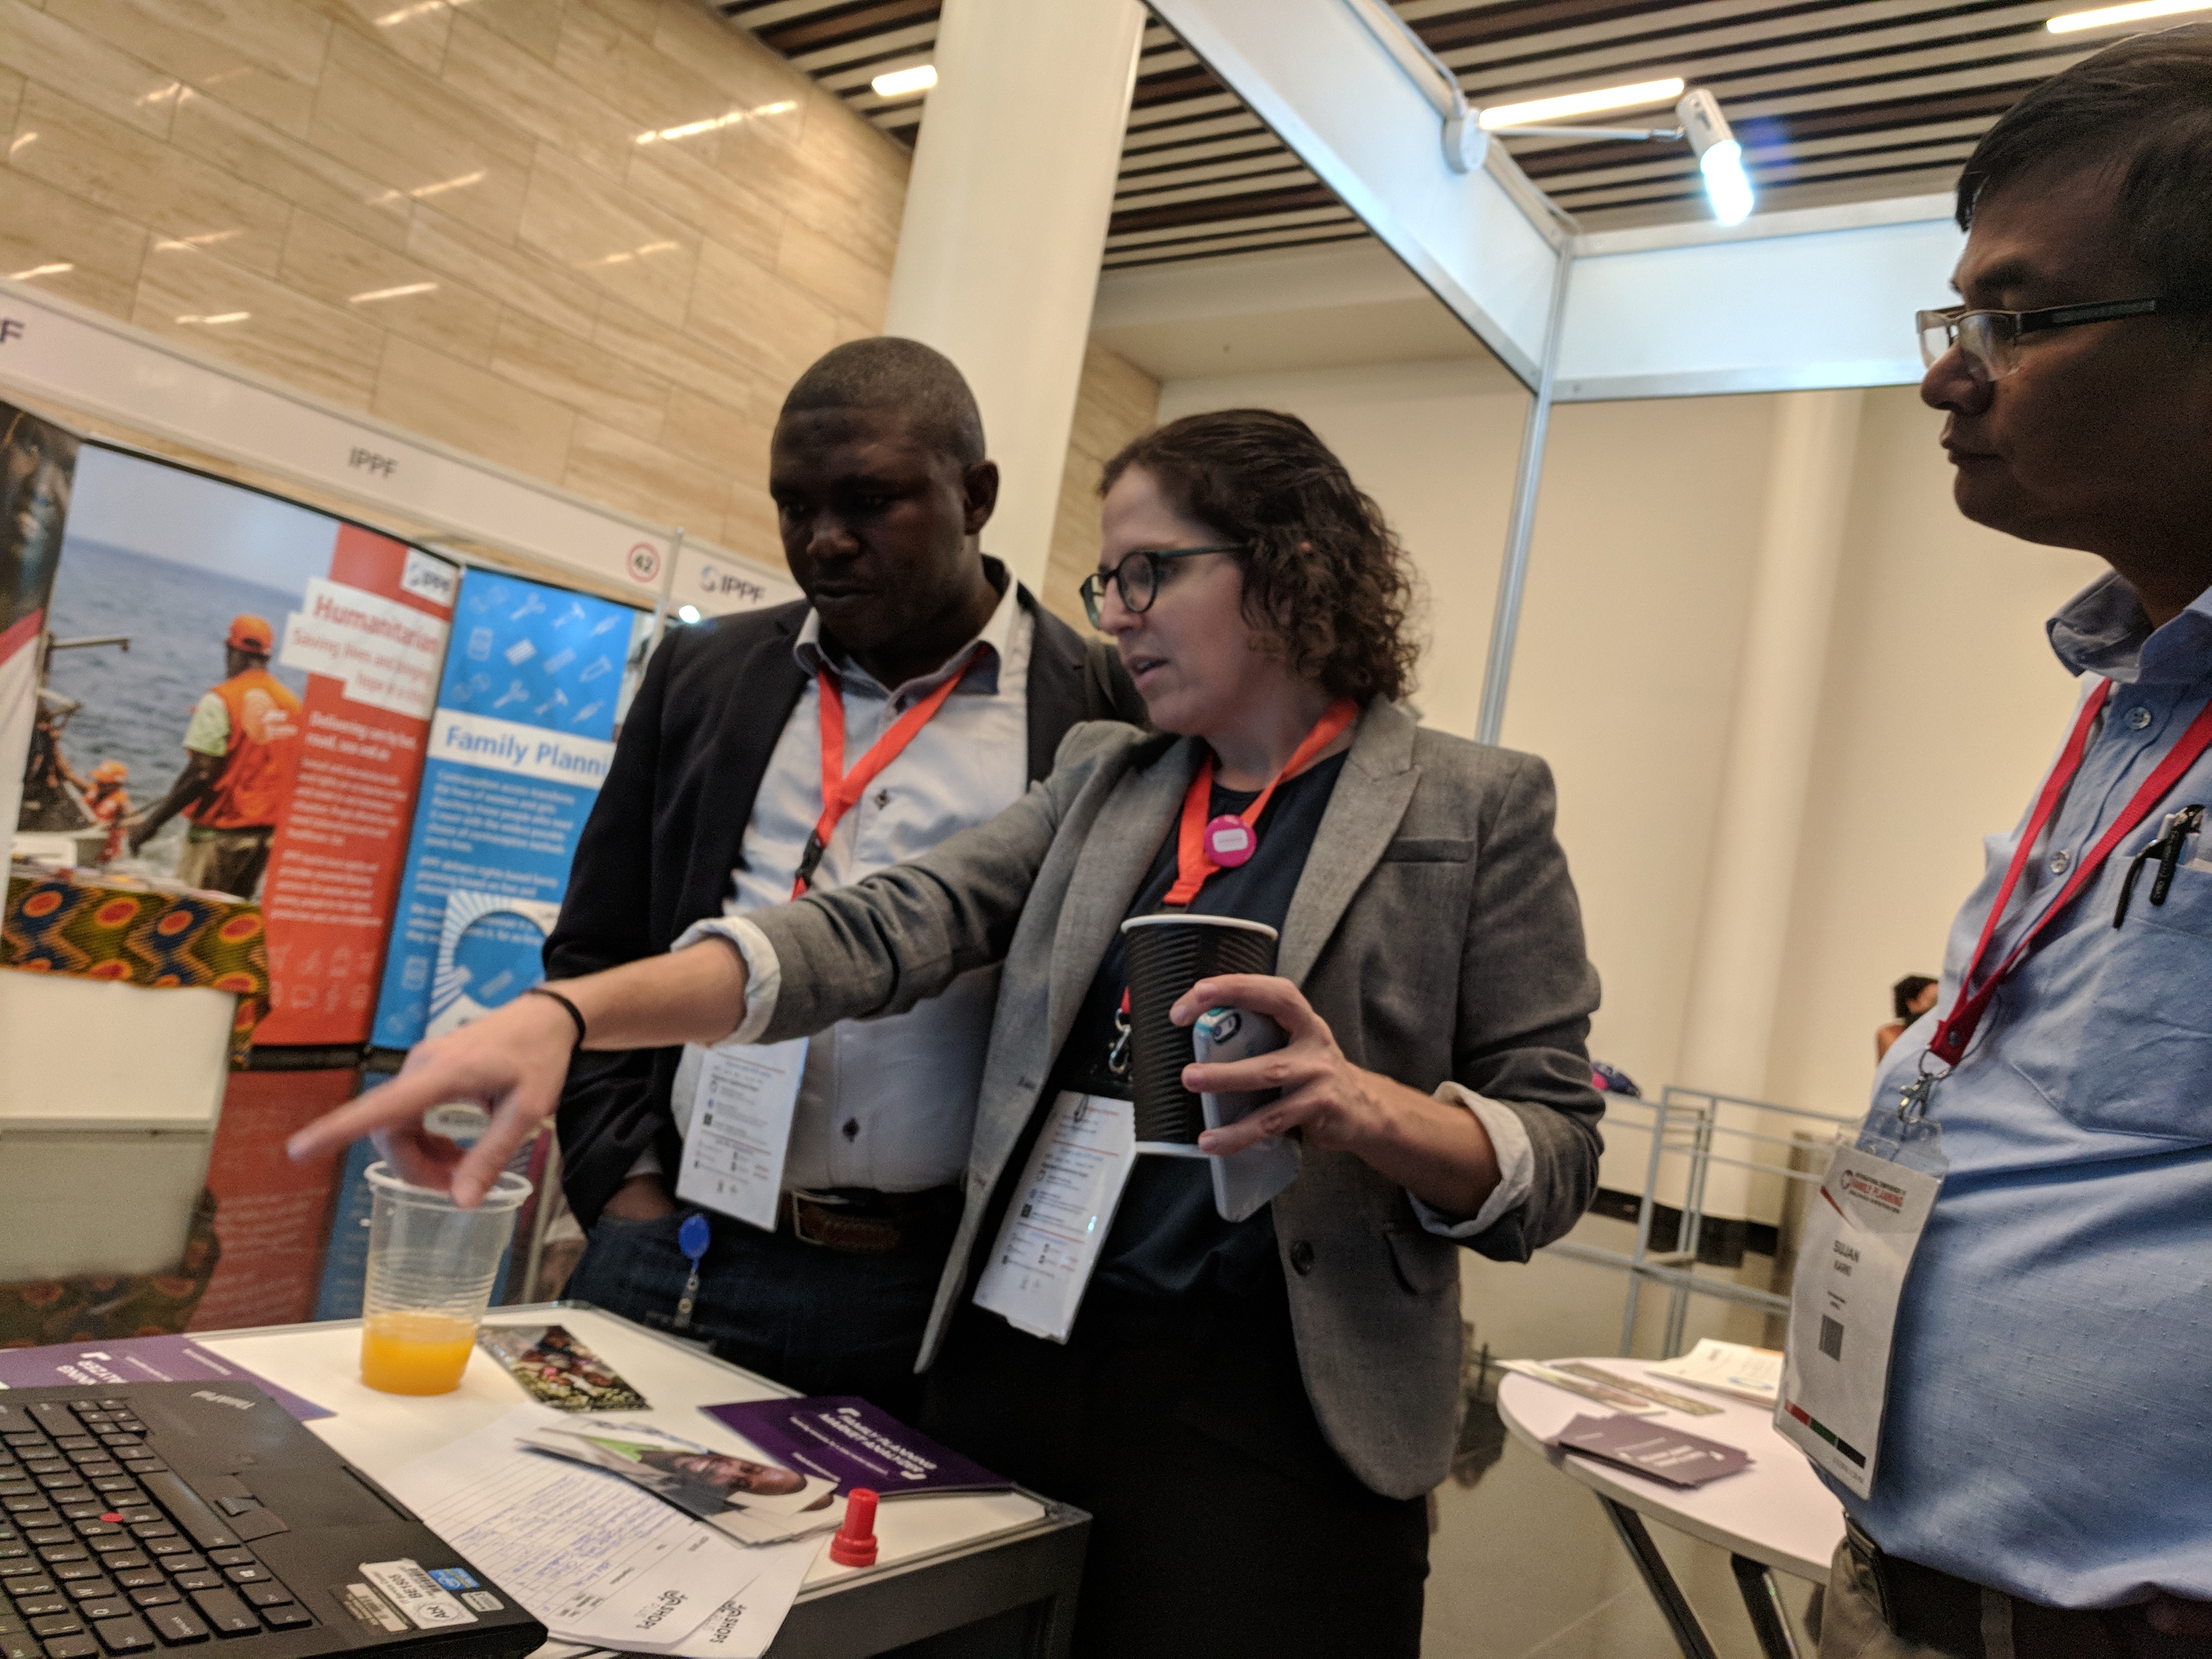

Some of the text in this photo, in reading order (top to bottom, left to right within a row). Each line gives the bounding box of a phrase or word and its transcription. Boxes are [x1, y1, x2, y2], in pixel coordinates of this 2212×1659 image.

[349, 446, 399, 479] IPPF
[634, 554, 653, 572] 42
[719, 574, 767, 603] IPPF
[445, 725, 529, 765] Family
[635, 1605, 675, 1630] SHOPS
[709, 1617, 739, 1644] SHOPS
